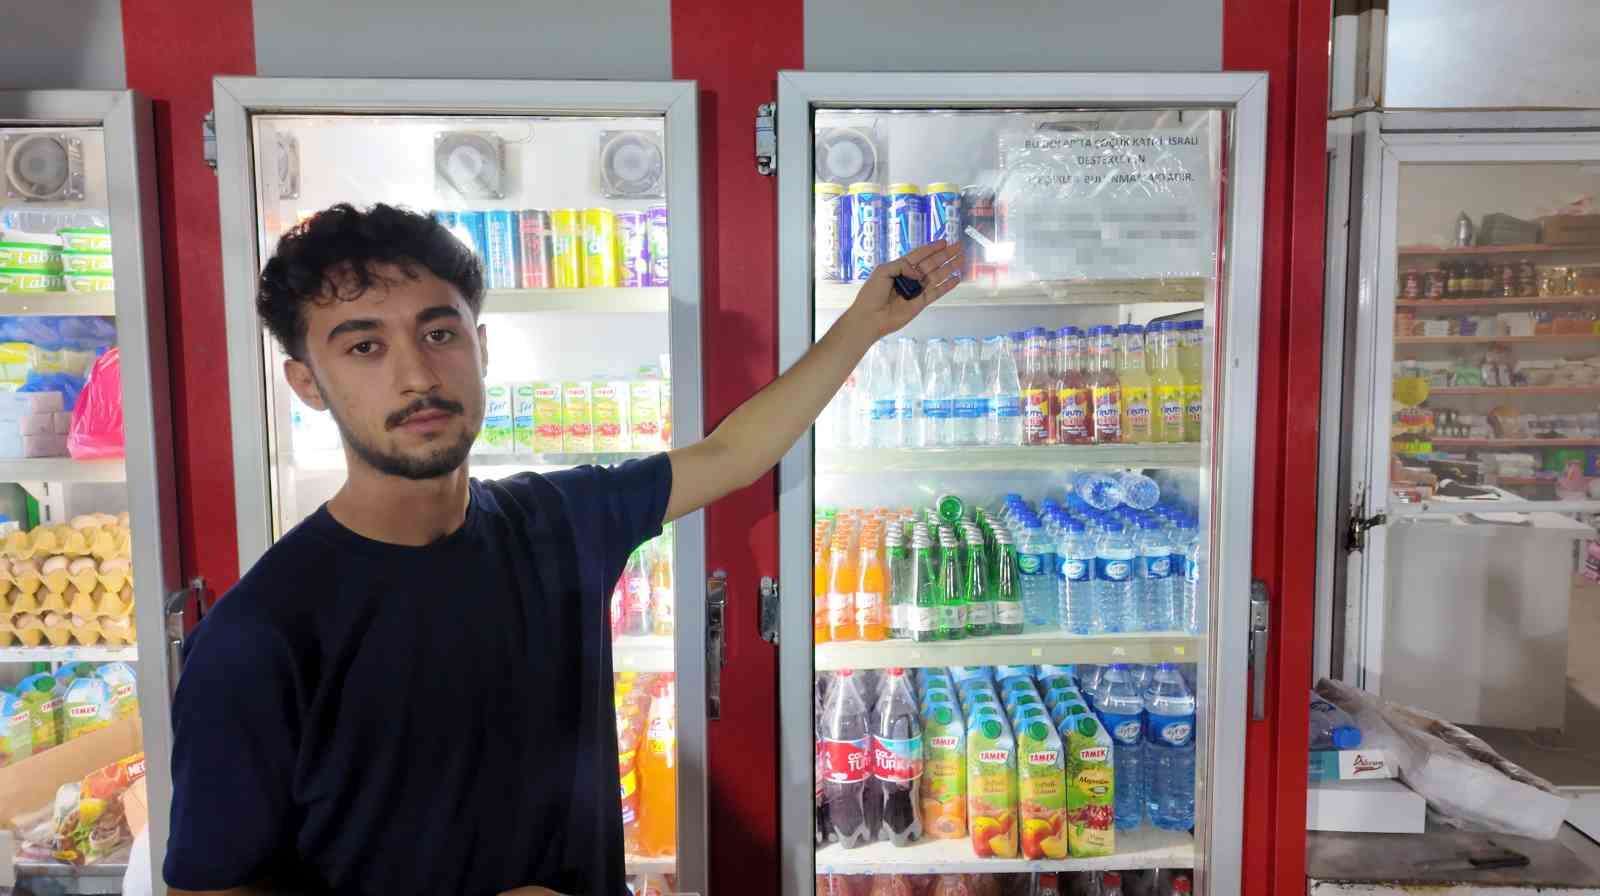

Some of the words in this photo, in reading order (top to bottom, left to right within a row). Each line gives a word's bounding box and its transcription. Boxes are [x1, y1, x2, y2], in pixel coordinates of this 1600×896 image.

[1024, 138, 1040, 149] BU
[980, 750, 1006, 761] TAMEK
[1029, 752, 1056, 763] TAMEK
[1080, 748, 1105, 760] TAMEK
